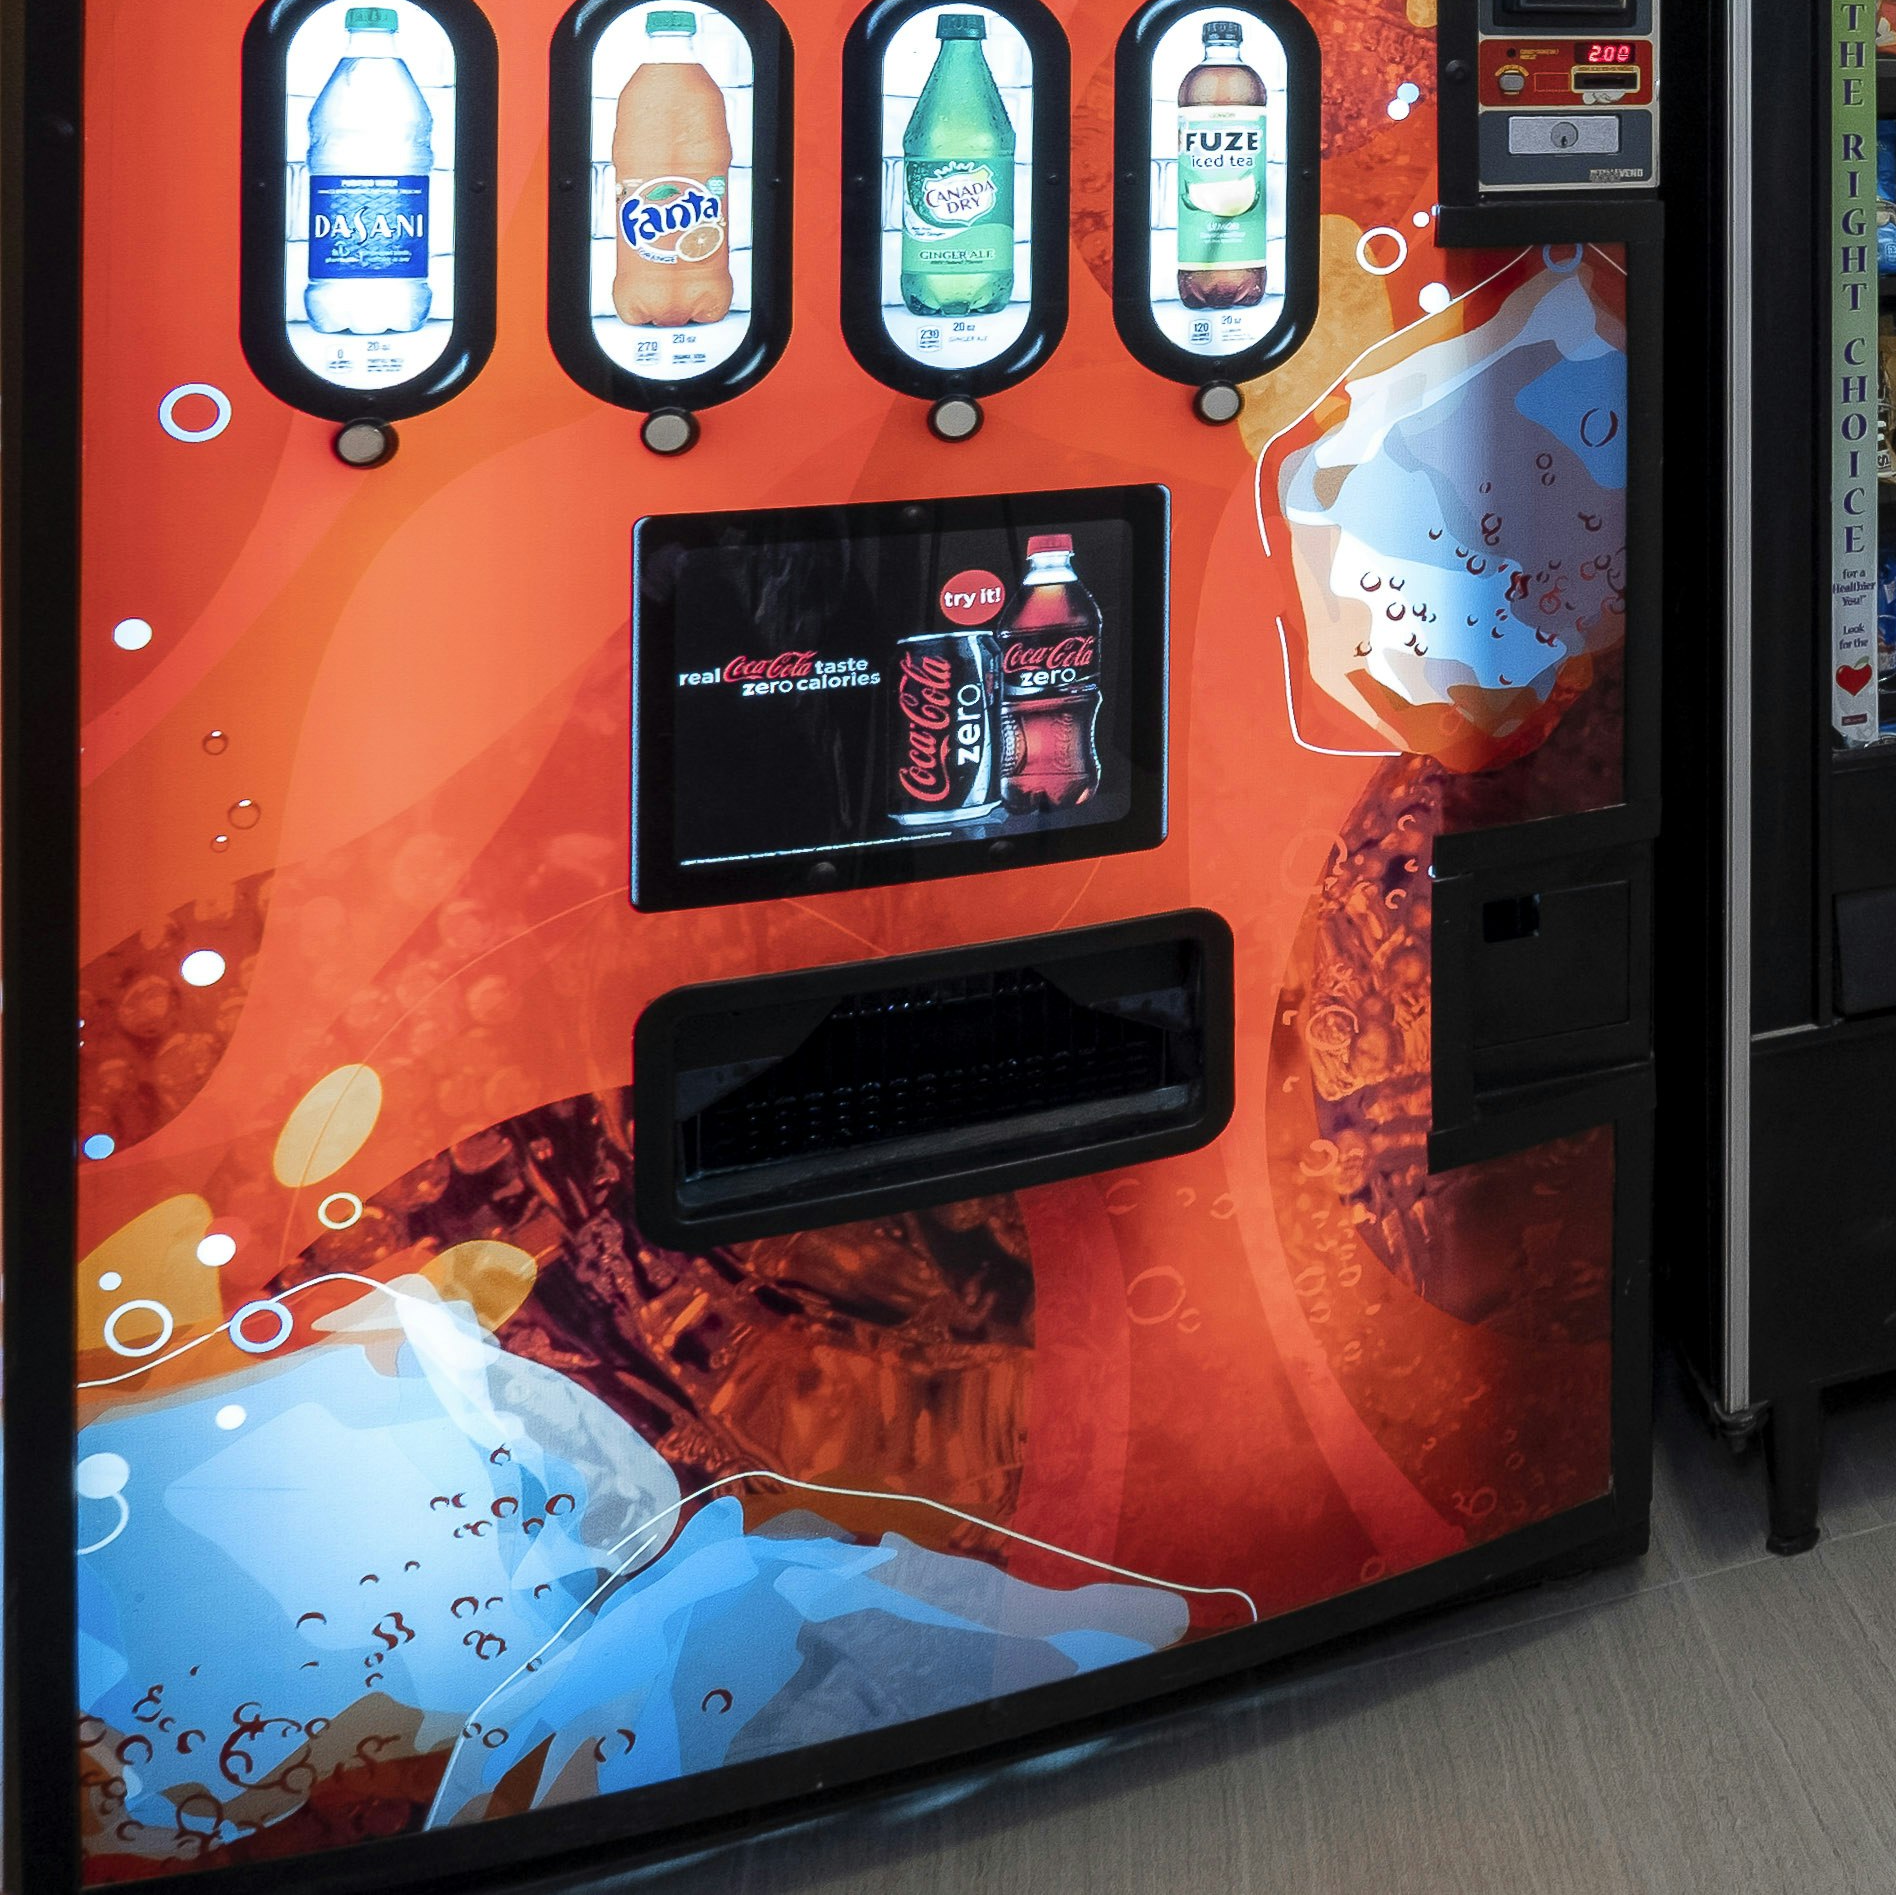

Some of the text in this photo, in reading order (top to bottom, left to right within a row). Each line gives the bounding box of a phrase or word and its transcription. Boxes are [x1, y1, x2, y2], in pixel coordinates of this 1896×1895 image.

[1186, 132, 1258, 152] FUZE
[1192, 154, 1254, 168] iced tea
[925, 180, 994, 208] CANADA
[947, 196, 981, 214] DRY
[315, 206, 423, 245] DASANI
[621, 190, 720, 247] Fanta
[1839, 3, 1869, 554] THE RIGHT CHOICE
[953, 321, 966, 332] 20
[1842, 568, 1867, 579] for a
[944, 587, 1002, 609] try it!
[1843, 623, 1865, 636] Look
[1002, 635, 1096, 674] Coca-Cola
[1839, 638, 1868, 650] for the
[679, 650, 868, 687] real Coca-Cola taste
[1020, 667, 1078, 687] zero
[742, 671, 881, 697] zero calories
[899, 651, 952, 803] Coca-Cola
[957, 682, 982, 767] zero
